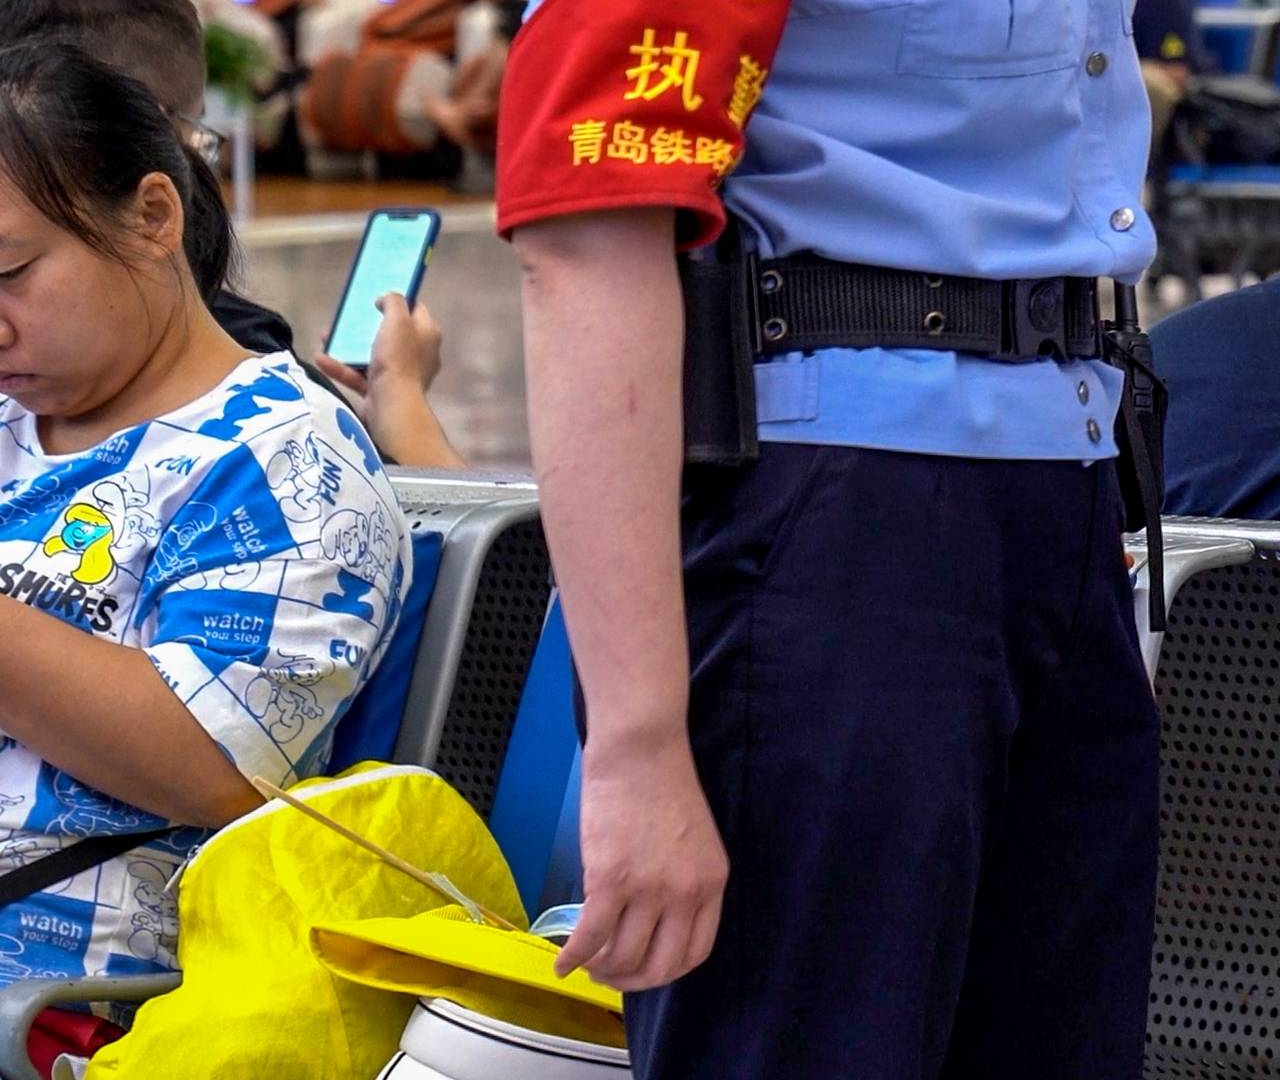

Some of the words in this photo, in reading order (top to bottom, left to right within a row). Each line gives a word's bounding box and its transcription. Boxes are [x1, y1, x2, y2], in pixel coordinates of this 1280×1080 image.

[320, 457, 342, 506] FUN
[0, 563, 119, 632] SMURFS
[203, 613, 265, 633] watch
[234, 631, 261, 646] step
[20, 912, 83, 940] watch
